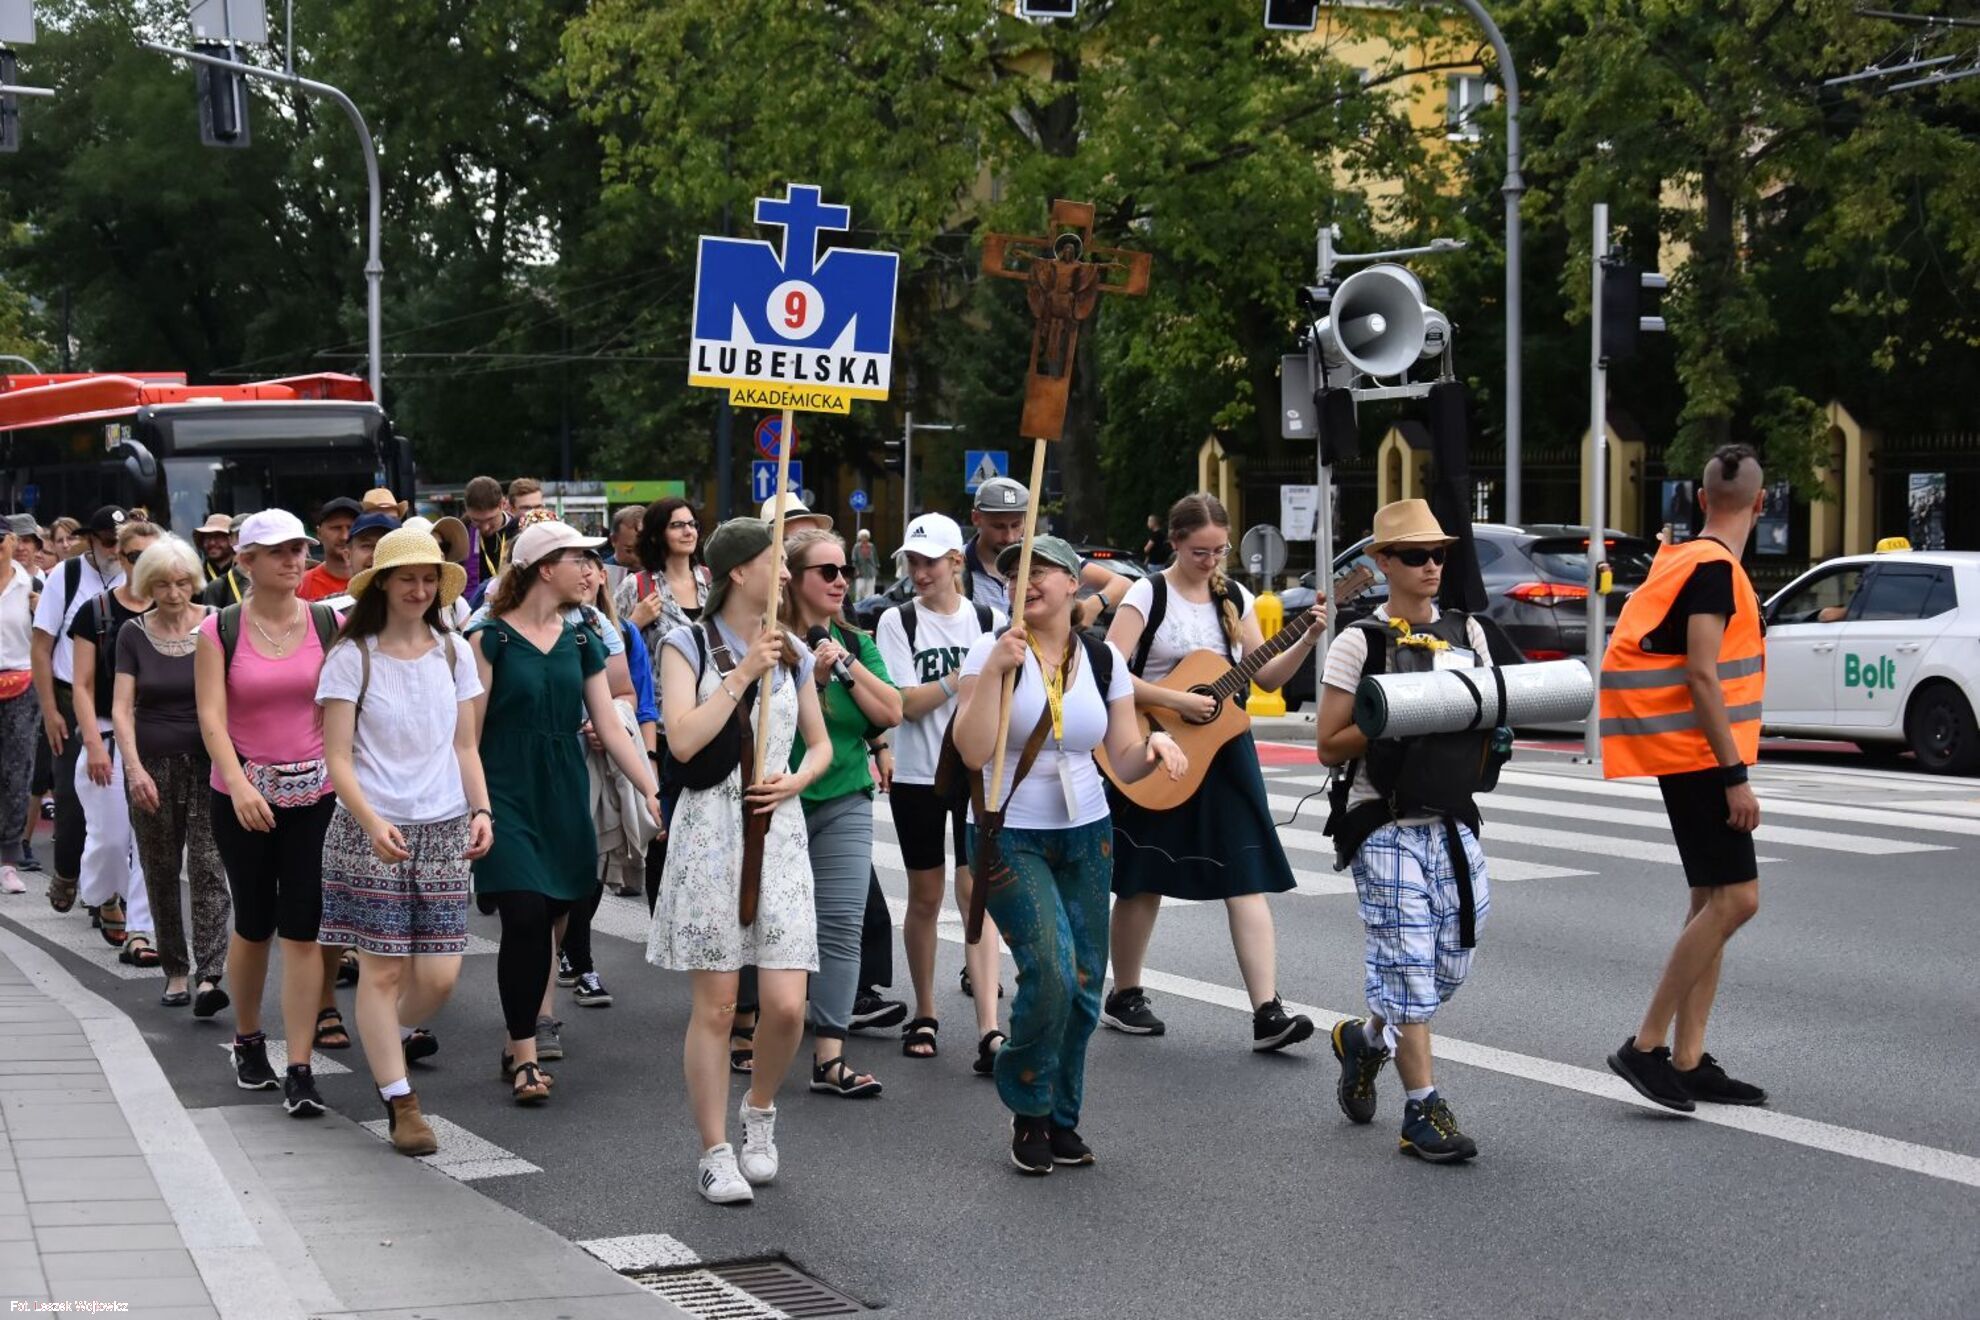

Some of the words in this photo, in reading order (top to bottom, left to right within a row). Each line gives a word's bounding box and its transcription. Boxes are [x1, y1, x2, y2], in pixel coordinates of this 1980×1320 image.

[784, 290, 807, 329] 9
[697, 345, 880, 386] LUBELSKA
[733, 389, 845, 410] AKADEMICKA
[1845, 653, 1896, 699] Bolt
